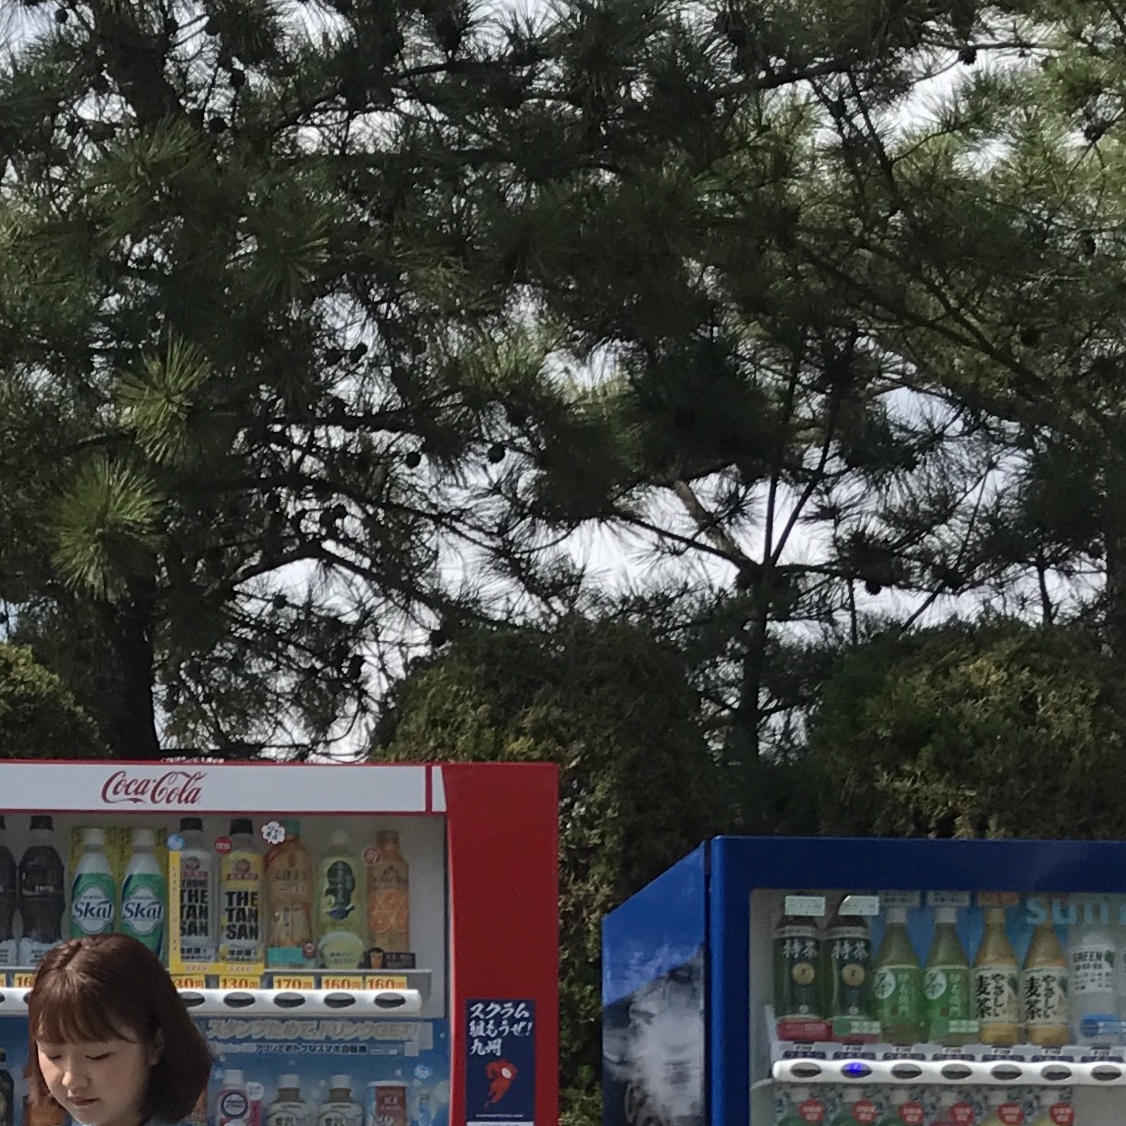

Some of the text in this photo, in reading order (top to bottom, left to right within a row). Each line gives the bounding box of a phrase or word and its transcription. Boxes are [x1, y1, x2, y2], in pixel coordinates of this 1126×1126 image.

[101, 770, 208, 805] Coca-Cola
[225, 890, 258, 907] THE
[225, 907, 259, 923] TAN
[226, 924, 259, 940] SAN
[975, 974, 991, 1019] 麦茶
[1025, 975, 1042, 1020] 麦茶
[469, 1002, 530, 1019] スクラム
[469, 1037, 502, 1056] 九州
